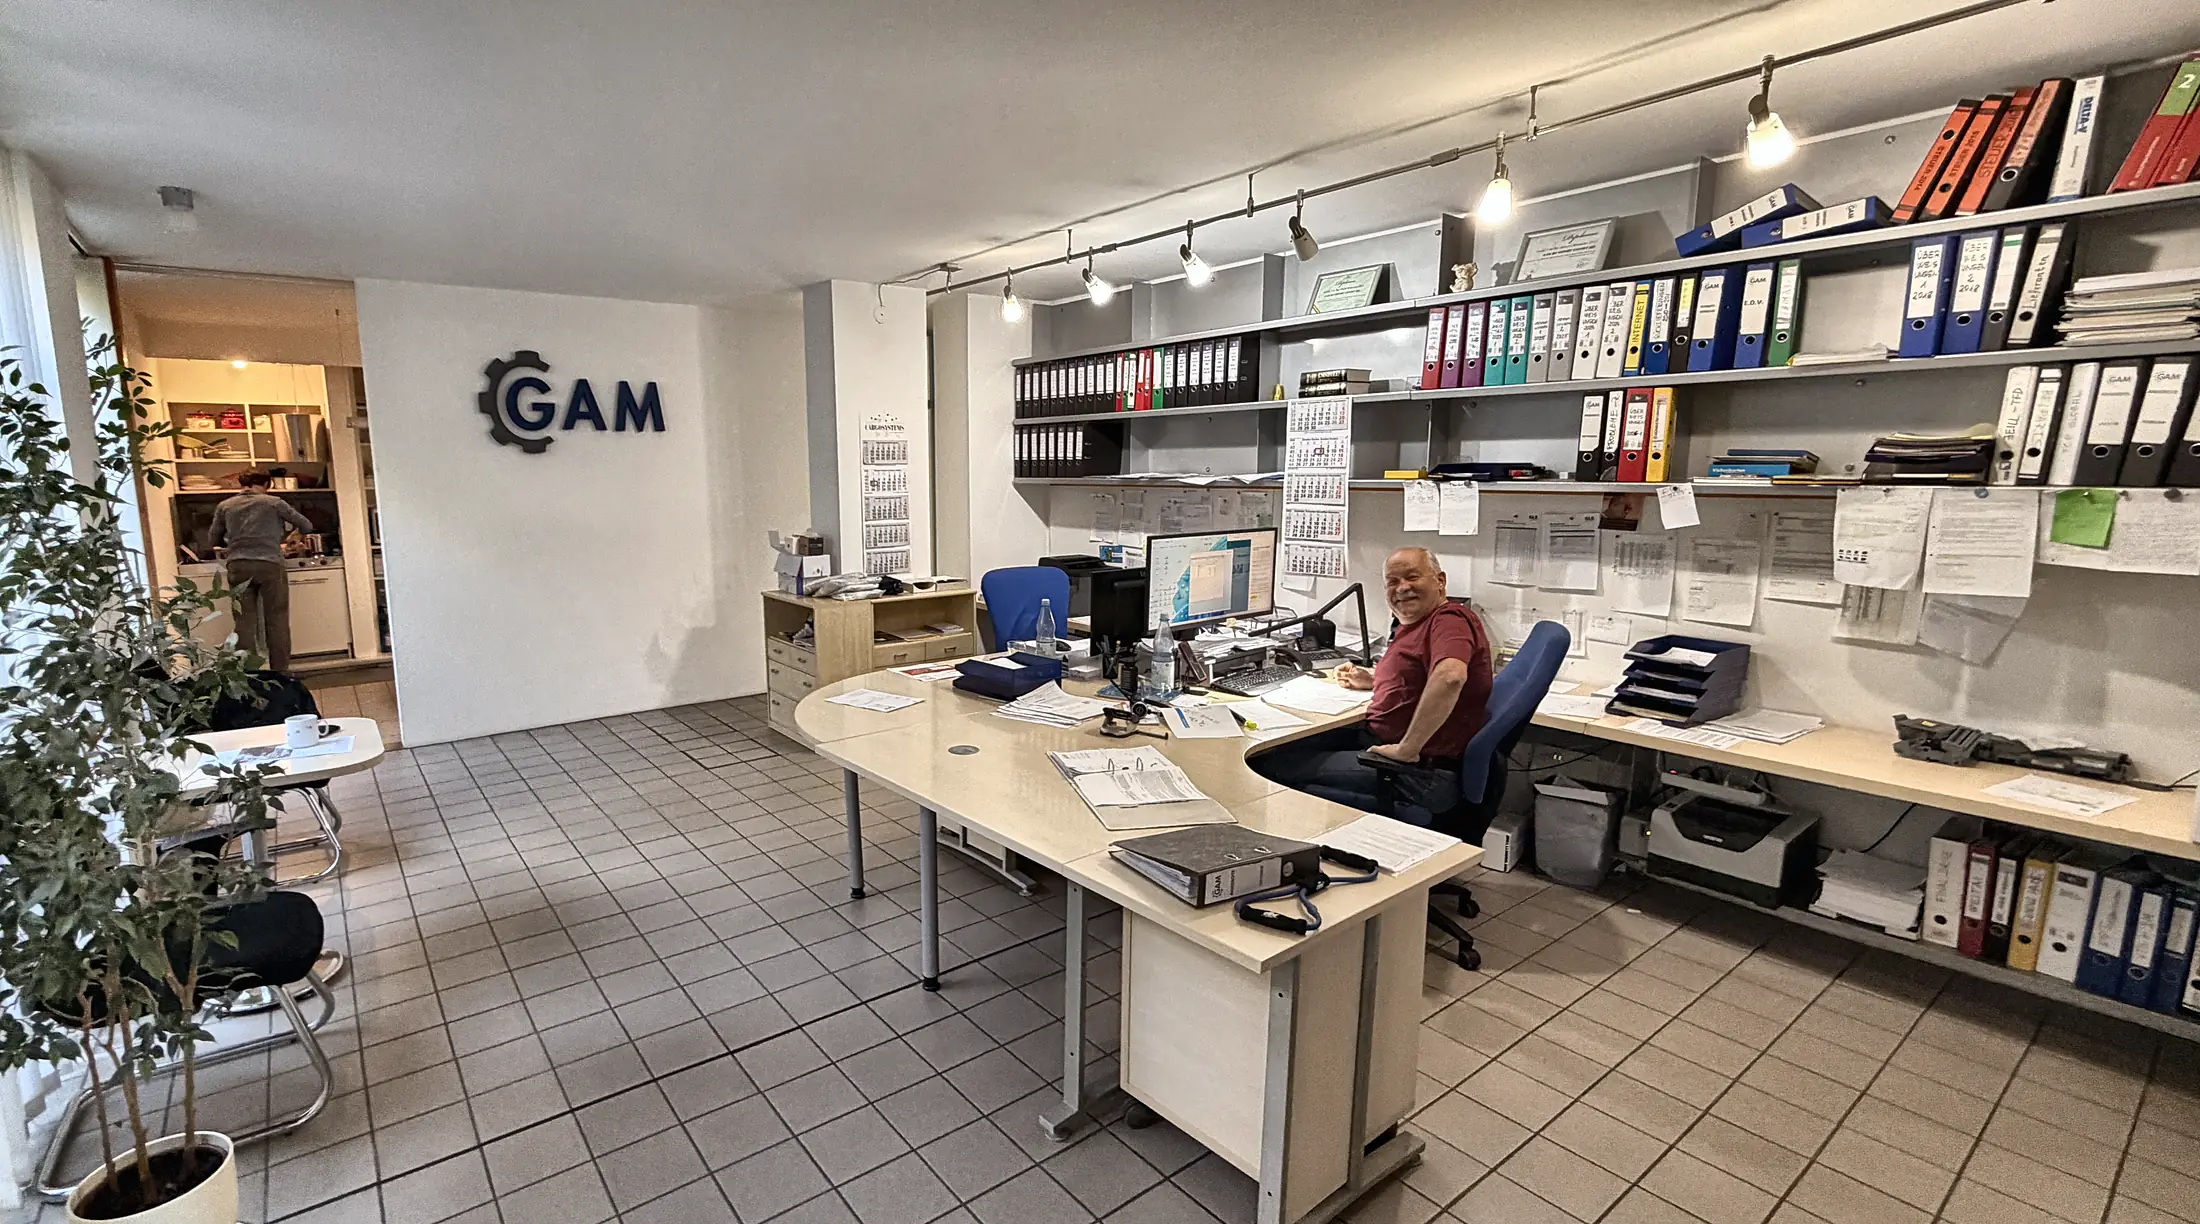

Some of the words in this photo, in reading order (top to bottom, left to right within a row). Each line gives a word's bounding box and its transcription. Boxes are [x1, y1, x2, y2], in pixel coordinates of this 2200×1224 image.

[2178, 74, 2196, 88] 2
[2080, 96, 2094, 133] DELTA-V
[1918, 250, 1939, 260] ÜBER
[1968, 274, 1974, 282] 2
[2022, 254, 2050, 310] Lieferanten
[1959, 284, 1980, 292] 2018
[1912, 291, 1934, 300] 2018
[1632, 300, 1645, 343] INTERNET
[506, 376, 666, 432] GAM
